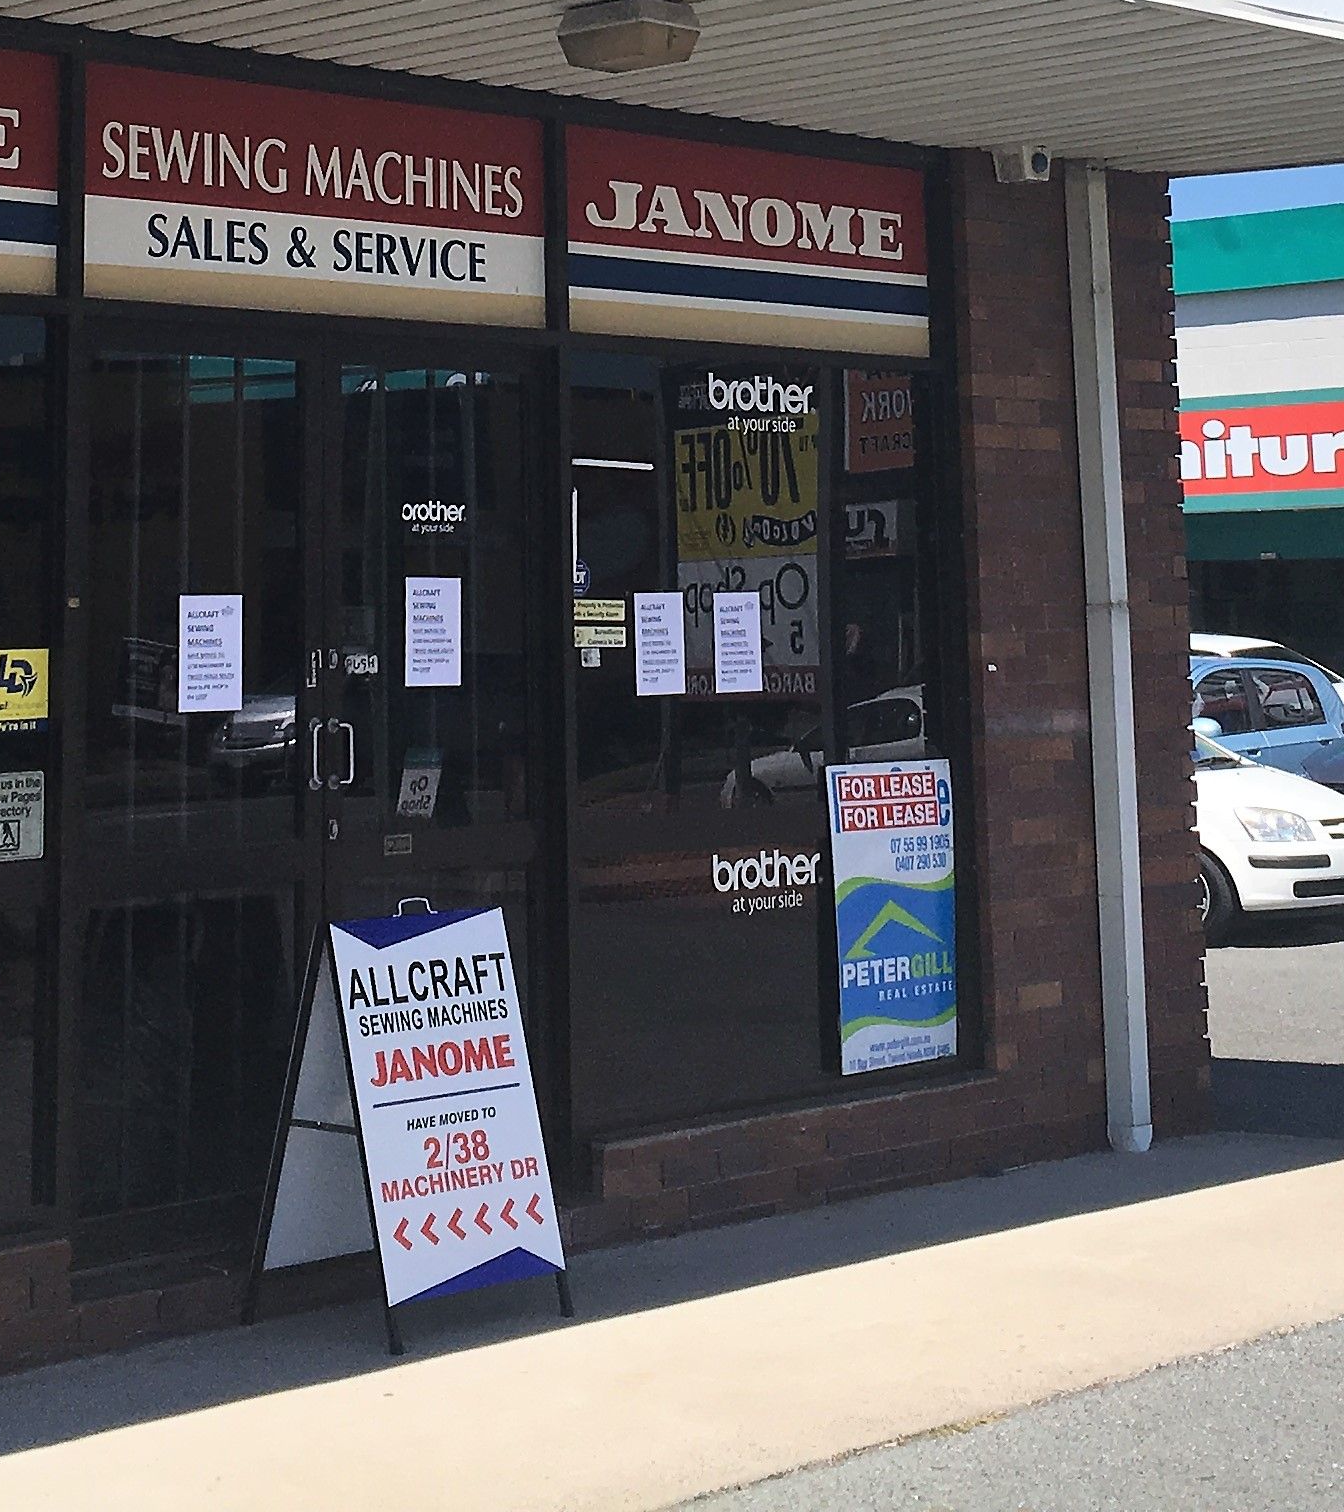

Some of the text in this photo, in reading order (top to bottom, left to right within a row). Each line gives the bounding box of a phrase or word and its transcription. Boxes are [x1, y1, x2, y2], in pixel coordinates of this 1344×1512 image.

[101, 120, 525, 220] SEWING MACHINES
[584, 179, 906, 262] JANOME
[147, 212, 488, 284] SALES & SERVICE
[708, 372, 813, 414] brother
[727, 416, 797, 435] at your side
[0, 780, 14, 789] us
[15, 778, 24, 788] in
[25, 777, 41, 788] the
[11, 791, 41, 804] Pages
[840, 774, 933, 799] FOR LEASE
[843, 807, 879, 829] FOR
[883, 802, 936, 826] LEASE
[890, 837, 902, 854] 07
[712, 849, 821, 893] brother
[732, 889, 804, 916] at your side
[348, 952, 506, 1010] ALLCRAFT
[878, 980, 953, 1002] REAL ESTATE
[359, 998, 509, 1037] SEWING MACHINES
[370, 1034, 516, 1088] JANOME
[406, 1106, 497, 1131] HAVE MOVED TO
[423, 1129, 490, 1170] 2/38
[381, 1156, 539, 1203] MACHINERY DR
